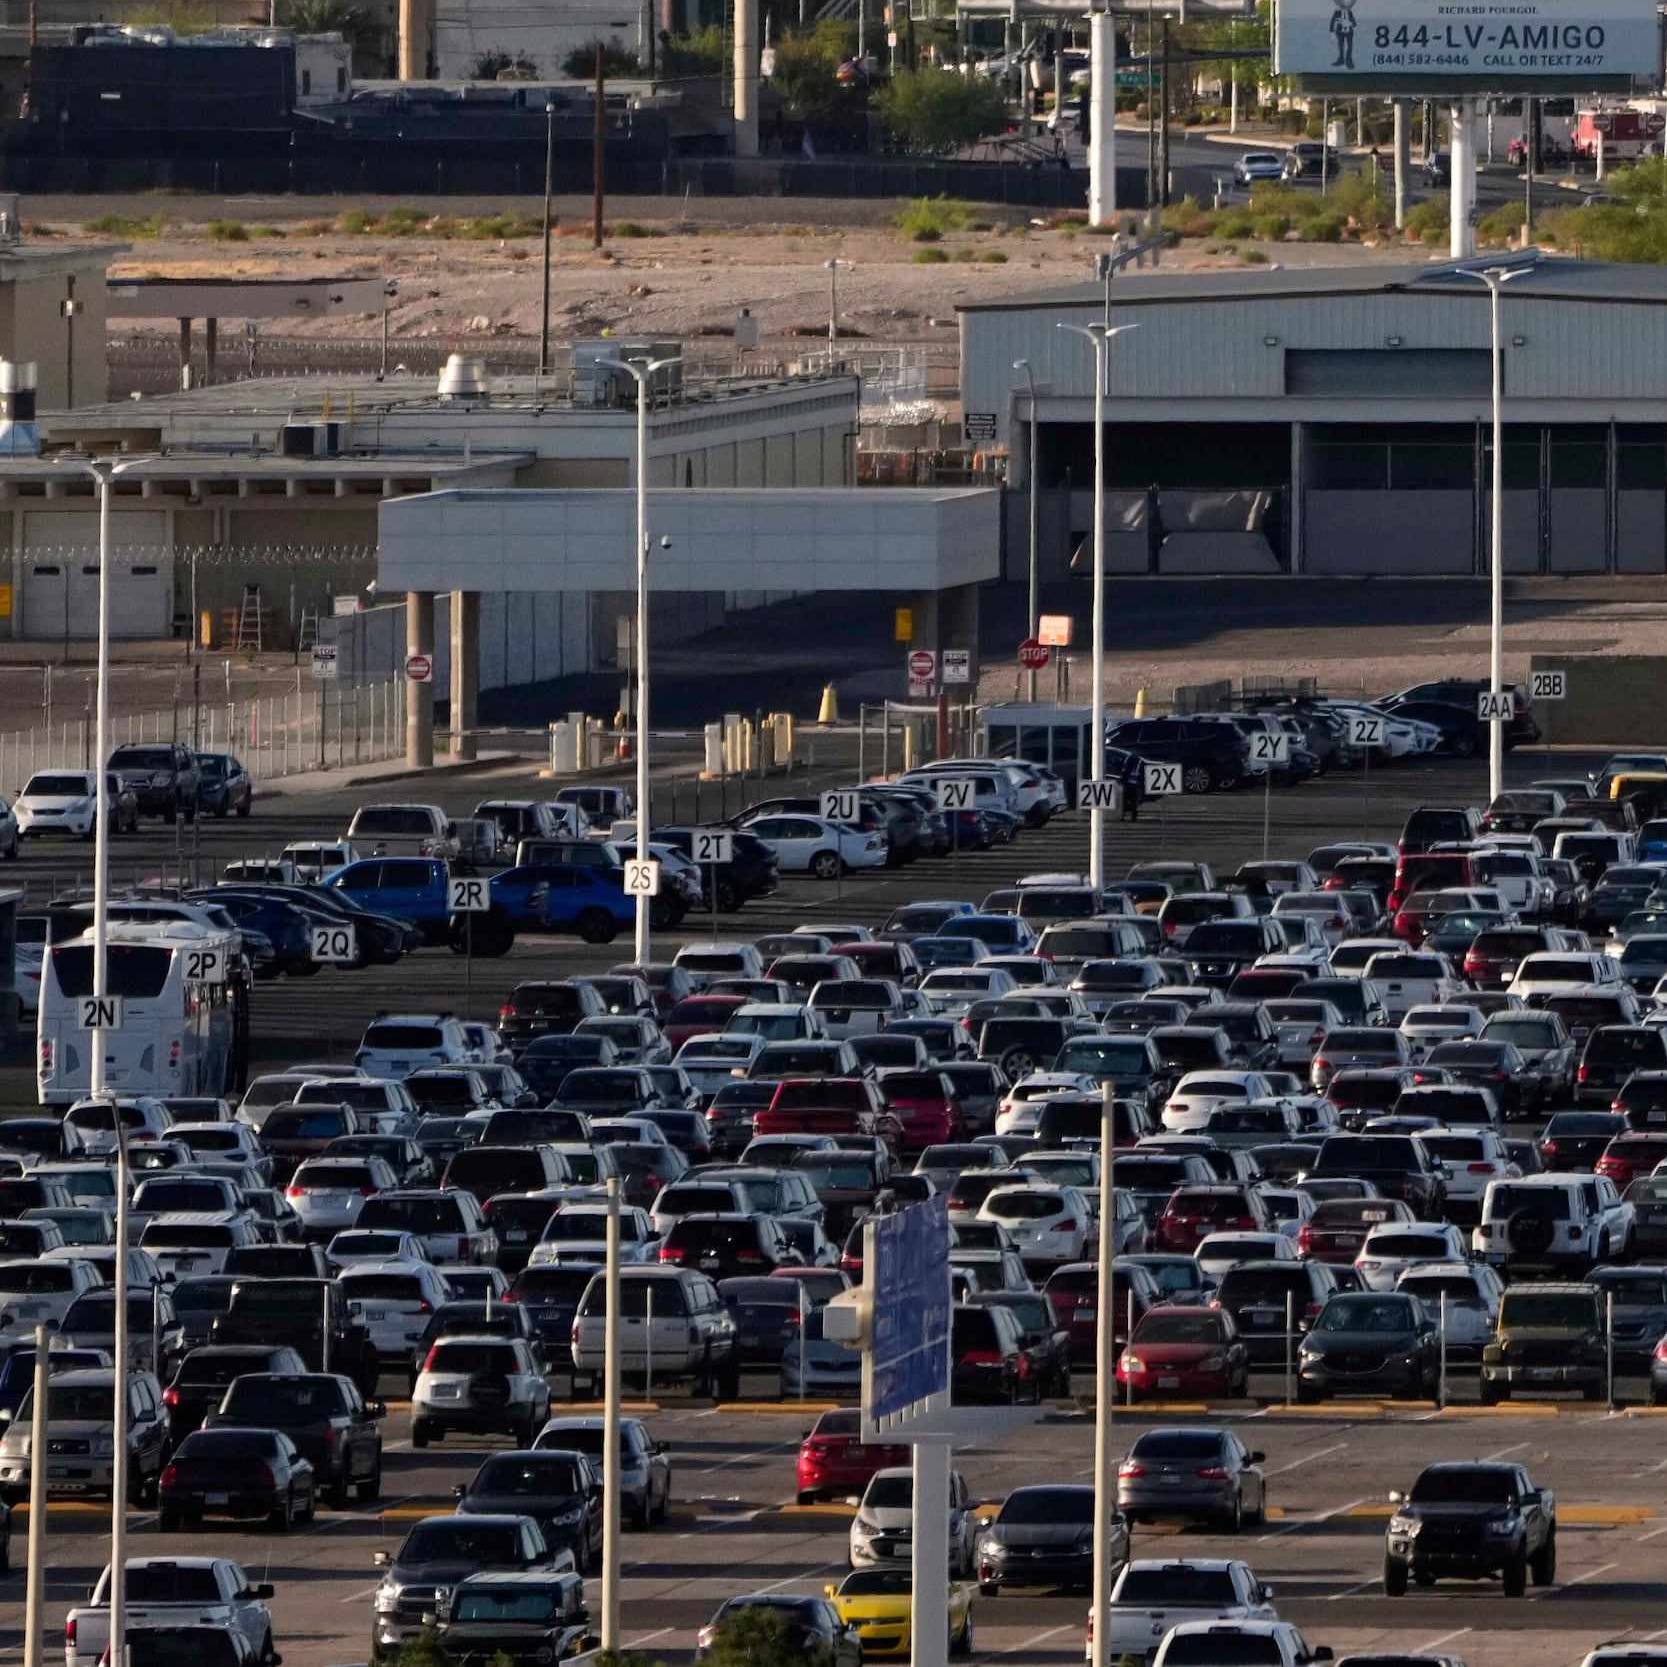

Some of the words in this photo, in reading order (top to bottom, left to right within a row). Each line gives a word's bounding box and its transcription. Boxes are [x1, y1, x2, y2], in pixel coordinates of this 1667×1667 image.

[1438, 6, 1485, 15] RICHARD
[1489, 6, 1538, 15] POURGOL
[1374, 25, 1605, 50] 844-LV-AMIGO
[1372, 54, 1405, 67] (844)
[1407, 54, 1470, 66] 582-6446
[1483, 54, 1515, 66] CALL
[1519, 54, 1537, 66] OR
[1539, 54, 1572, 66] TEXT
[1575, 54, 1604, 67] 24/7
[1020, 647, 1048, 661] STOP
[1534, 674, 1563, 697] 2BB
[1479, 695, 1511, 718] 2AA
[1355, 720, 1379, 743] 2Z
[1256, 735, 1282, 759] 2Y
[1150, 767, 1176, 791] 2X
[826, 794, 854, 820] 2U
[943, 783, 970, 808] 2V
[1080, 783, 1113, 807] 2W
[698, 834, 725, 860] 2T
[631, 866, 651, 890] 2S
[453, 881, 483, 908] 2R
[316, 930, 349, 959] 2Q
[186, 952, 217, 980] 2P
[84, 999, 115, 1028] 2N
